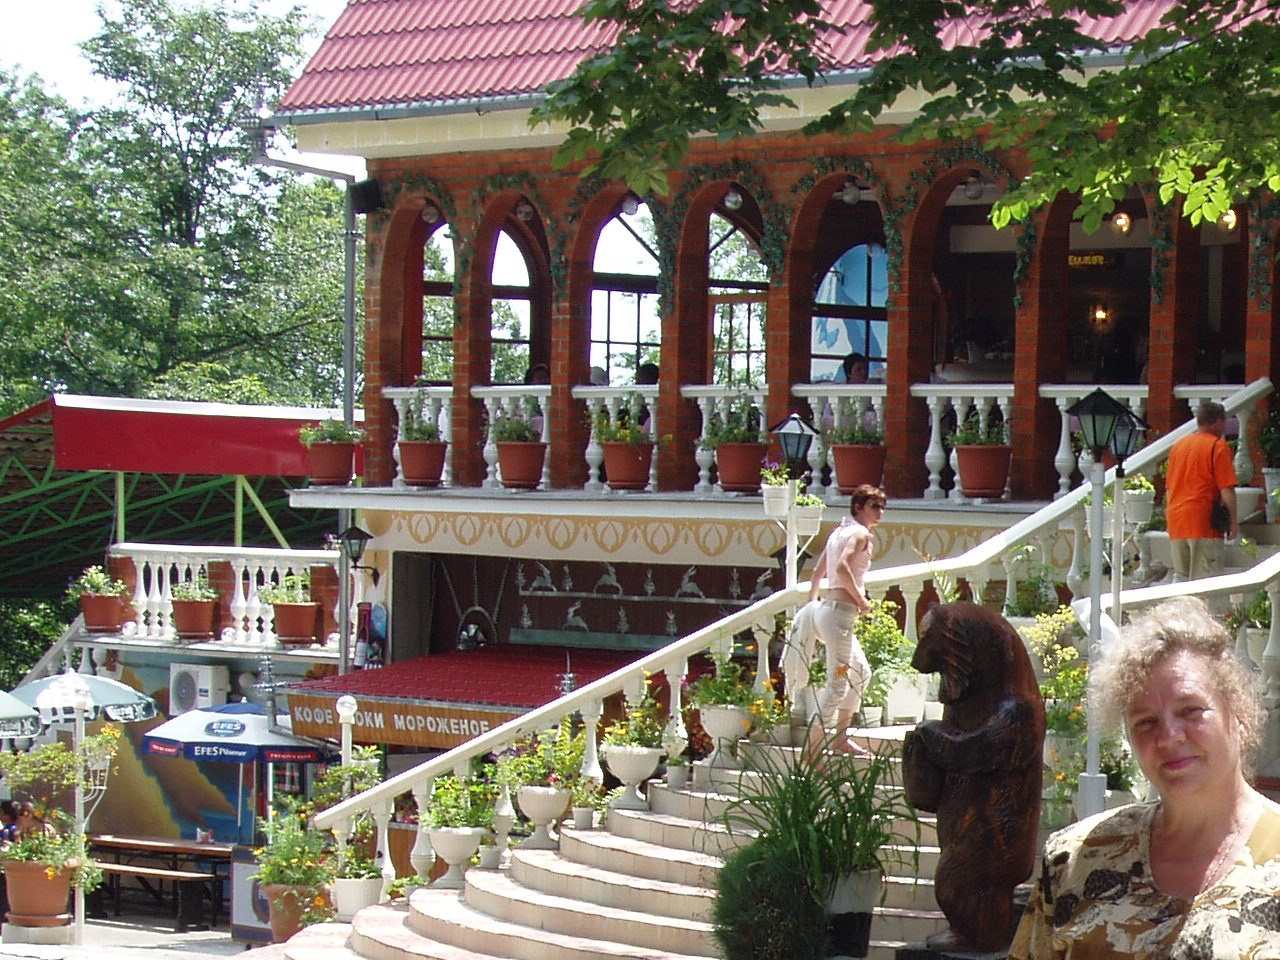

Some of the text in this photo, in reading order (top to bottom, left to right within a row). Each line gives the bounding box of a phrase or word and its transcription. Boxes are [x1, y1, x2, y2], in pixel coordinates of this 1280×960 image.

[294, 706, 489, 736] КОФЕ ОКИ МОРОЖЕНОЕ
[194, 745, 218, 756] EFES
